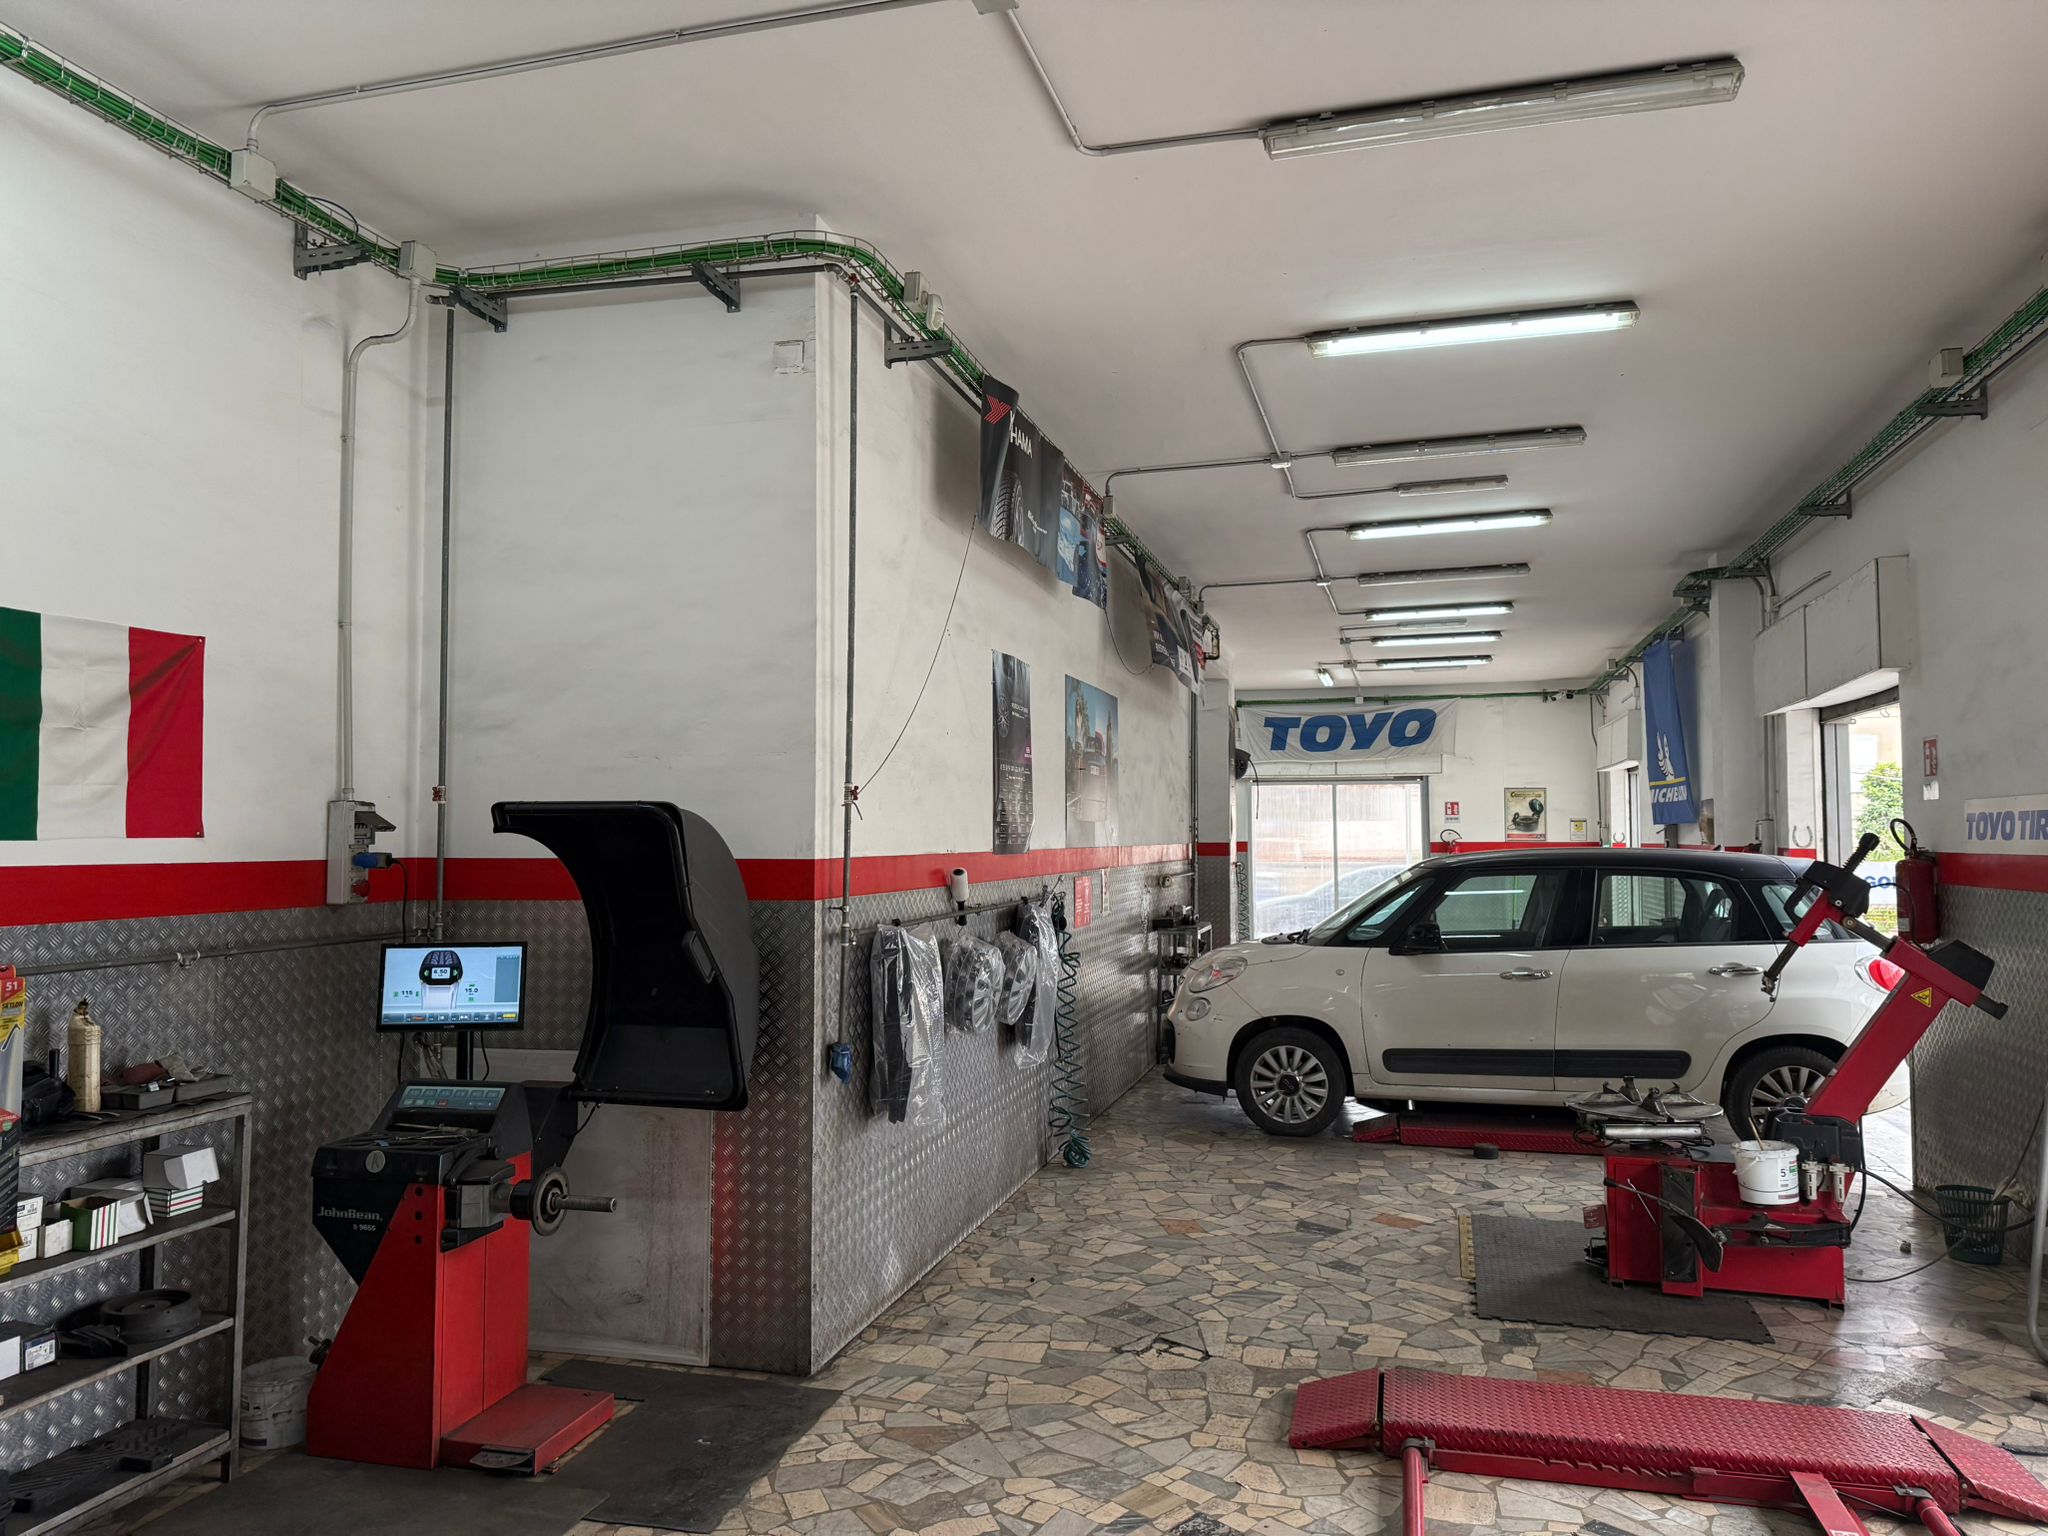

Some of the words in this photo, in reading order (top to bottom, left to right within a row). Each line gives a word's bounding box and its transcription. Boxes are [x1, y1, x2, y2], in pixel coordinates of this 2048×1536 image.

[1009, 410, 1033, 459] YHAMA
[1264, 708, 1437, 752] TOYO
[1966, 811, 2016, 841] TOYO
[2018, 810, 2048, 840] TIR
[6, 981, 18, 991] 51
[1780, 1168, 1787, 1178] 5
